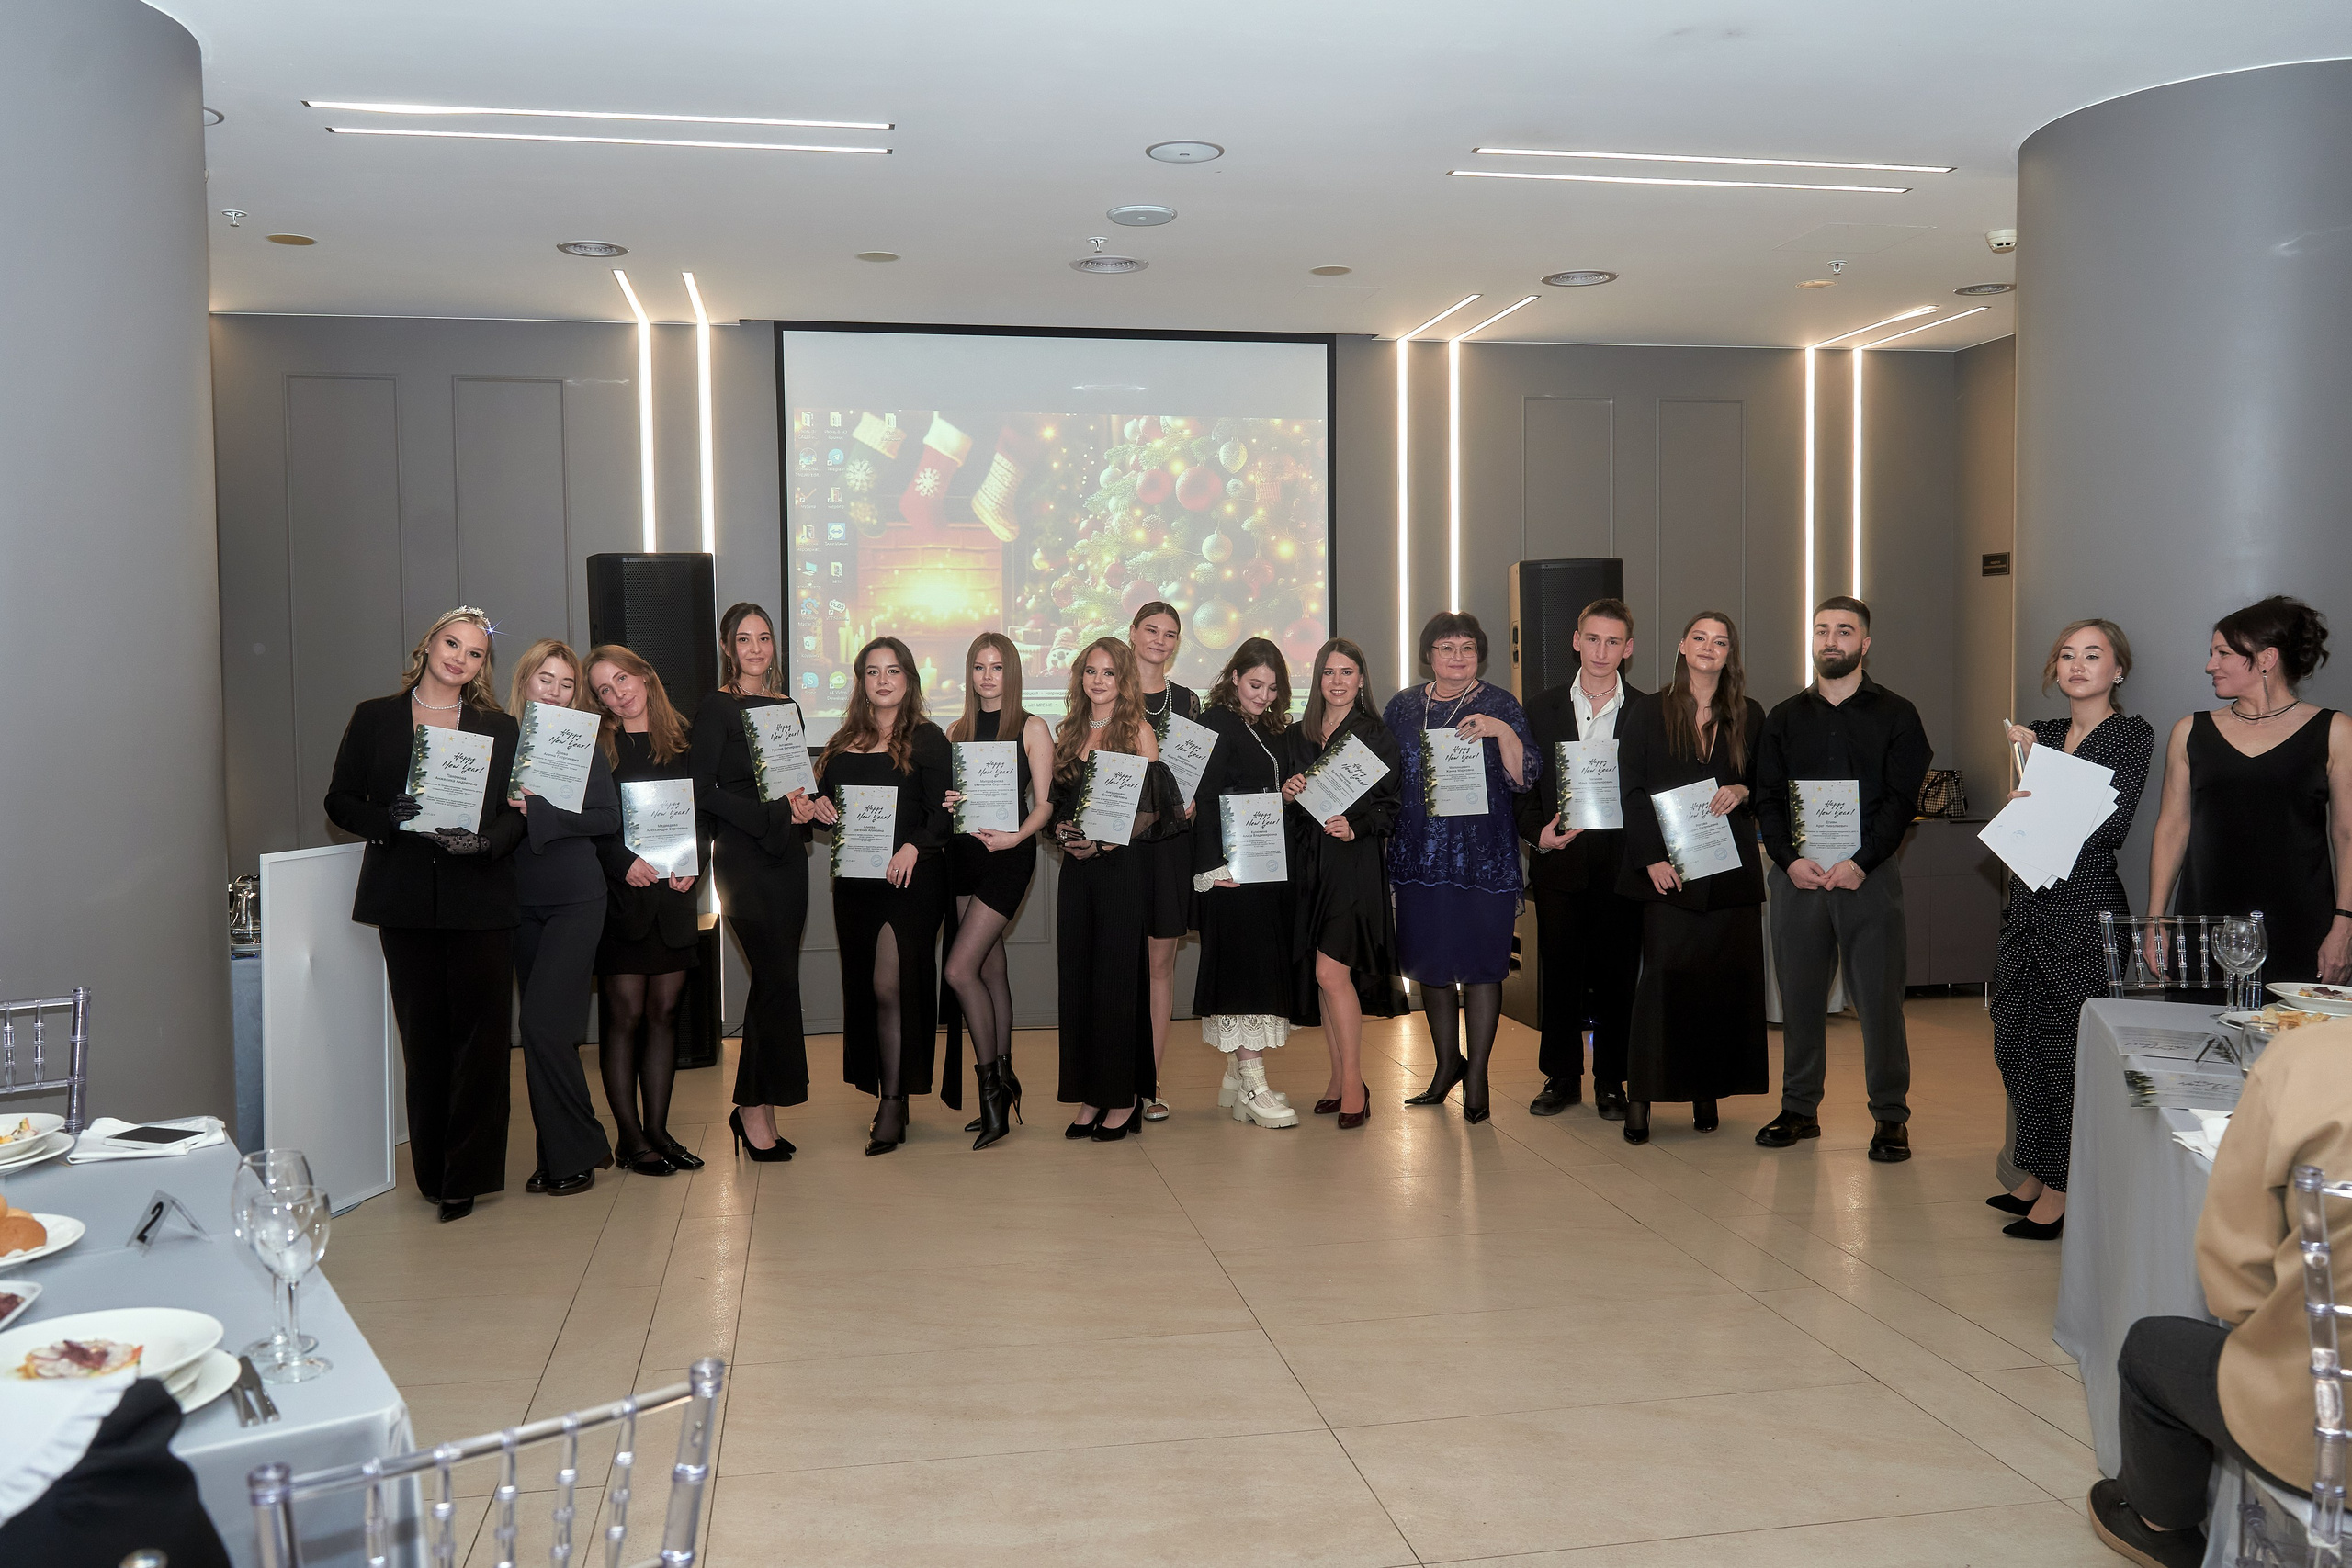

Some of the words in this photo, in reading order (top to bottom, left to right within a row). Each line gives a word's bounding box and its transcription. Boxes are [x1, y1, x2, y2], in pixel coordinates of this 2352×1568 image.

[560, 728, 582, 740] Happy
[770, 732, 783, 741] New
[785, 730, 799, 741] Year!
[549, 737, 567, 745] New
[567, 740, 591, 750] Year!
[1185, 739, 1201, 751] Happy
[1175, 744, 1188, 752] New
[1188, 750, 1206, 761] Year!
[1453, 746, 1470, 754] Happy
[454, 752, 476, 764] Happy
[1445, 753, 1459, 762] New
[1462, 753, 1480, 762] Year!
[442, 761, 459, 770] New
[461, 765, 484, 773] Year!
[986, 761, 1005, 769] Happy
[1353, 763, 1367, 776] Happy
[978, 768, 992, 776] New
[995, 769, 1013, 778] Year!
[1341, 763, 1354, 773] New
[1350, 774, 1368, 786] Year!
[1581, 766, 1595, 774] New
[1598, 766, 1616, 775] Year!
[1114, 772, 1132, 781] Happy
[865, 805, 883, 814] Happy
[1825, 800, 1845, 809] Happy
[650, 809, 666, 818] New
[670, 808, 690, 819] Year!
[856, 812, 870, 821] New
[872, 814, 891, 822] Year!
[1253, 811, 1271, 819] Happy
[1816, 808, 1831, 817] New
[1834, 809, 1855, 818] Year!
[1246, 819, 1259, 828] New
[1261, 819, 1280, 829] Year!
[136, 1201, 164, 1244] 2
